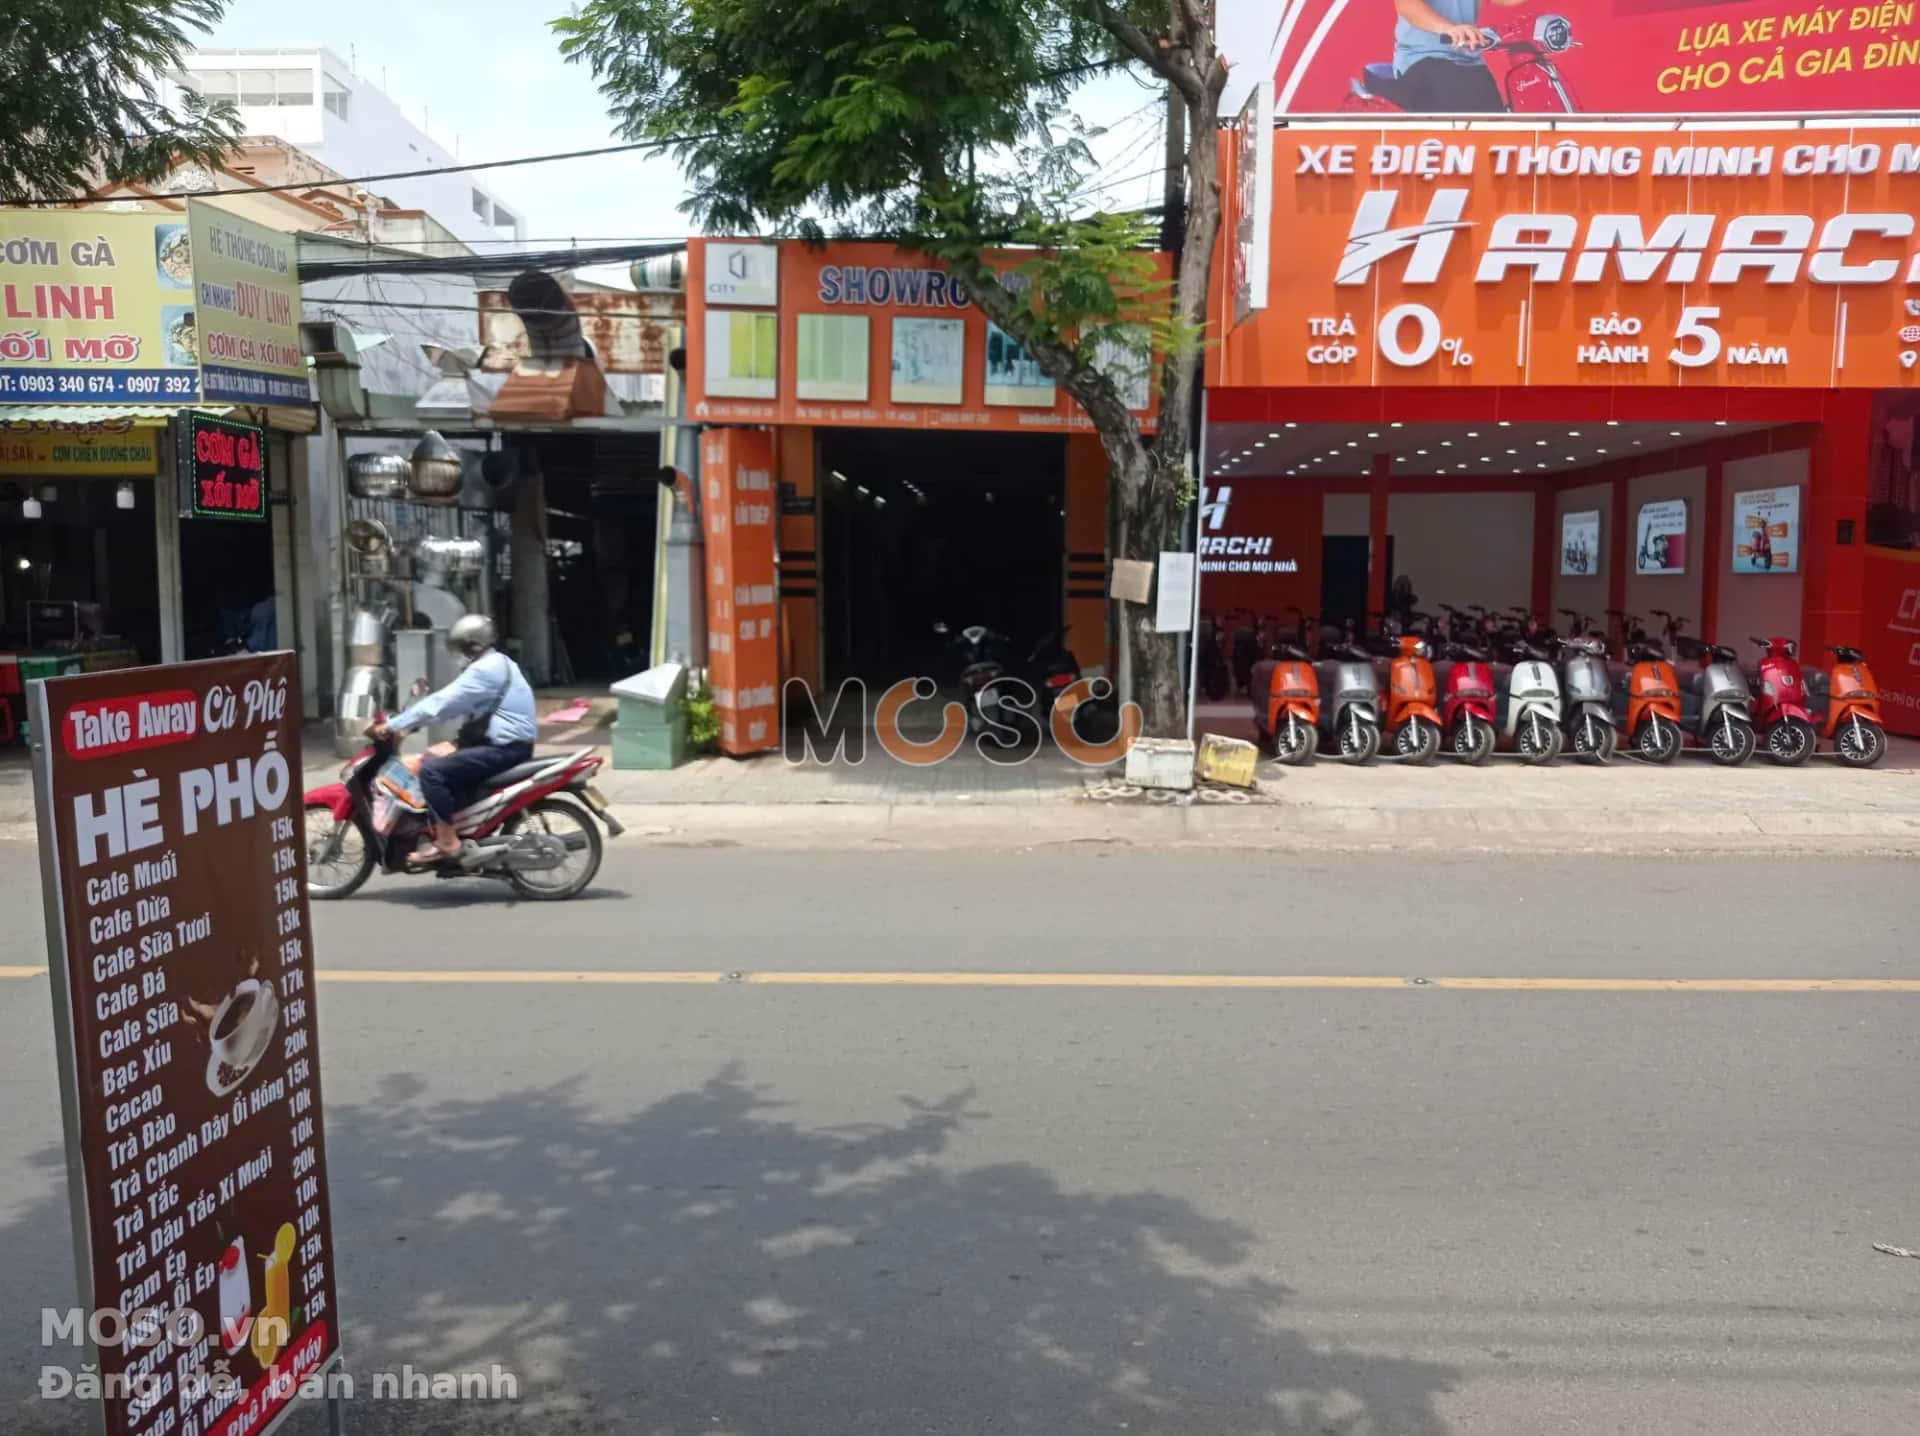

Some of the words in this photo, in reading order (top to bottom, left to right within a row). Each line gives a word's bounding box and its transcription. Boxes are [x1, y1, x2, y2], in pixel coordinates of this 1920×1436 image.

[1677, 23, 1731, 56] LỰA
[1738, 17, 1776, 44] XE
[1781, 5, 1844, 39] MÁY
[1849, 0, 1914, 34] ĐIỆN
[1656, 61, 1731, 94] CHO
[1738, 46, 1785, 85] CẢ
[1795, 46, 1853, 77] GIA
[1863, 34, 1920, 69] ĐÌN
[1295, 145, 1357, 175] XE
[1370, 139, 1476, 181] ĐIỆN
[1489, 140, 1641, 176] THÔNG
[1651, 145, 1774, 176] MINH
[1782, 143, 1881, 176] CHO
[70, 236, 115, 266] GÀ
[1333, 189, 1920, 285] HAMAC
[4, 284, 115, 319] LINH
[264, 289, 292, 326] LINH
[1308, 313, 1356, 336] TRẢ
[1589, 312, 1642, 336] BẢO
[0, 330, 48, 359] ỐI
[65, 334, 138, 360] MỠ
[1306, 340, 1358, 364] GÓP
[1577, 341, 1649, 364] HÀNH
[1668, 306, 1722, 367] 5
[0, 376, 16, 391] T:
[19, 375, 55, 392] 0903
[59, 376, 85, 392] 340
[88, 376, 114, 392] 674
[127, 377, 160, 393] 0907
[165, 377, 191, 393] 392
[196, 428, 235, 467] CƠM
[238, 431, 261, 471] GÀ
[1228, 561, 1250, 572] CHO
[1252, 561, 1272, 574] MỌI
[1274, 558, 1298, 572] NHÀ
[70, 707, 131, 750] Take
[138, 700, 197, 739] Away
[203, 685, 239, 733] Cà
[243, 677, 288, 730] Phê
[73, 768, 164, 867] HÈ
[179, 730, 290, 836] PHỐ
[86, 871, 129, 906] Cafe
[133, 849, 178, 890] Muối
[270, 816, 294, 842] 15k
[90, 909, 132, 944] Cafe
[136, 895, 171, 927] Dừa
[272, 847, 296, 874] 15k
[93, 945, 136, 982] Cafe
[140, 930, 173, 962] Sữa
[176, 911, 211, 947] Tươi
[274, 877, 299, 905] 15k
[96, 983, 139, 1020] Cafe
[142, 966, 166, 1000] Đá
[277, 907, 301, 936] 13k
[99, 1019, 141, 1058] Cafe
[146, 1002, 179, 1035] Sữa
[279, 938, 303, 966] 15k
[102, 1060, 139, 1097] Bạc
[280, 968, 305, 997] 17k
[106, 1084, 162, 1134] Cacao
[283, 998, 306, 1028] 15k
[107, 1132, 139, 1171] Trà
[142, 1112, 176, 1150] Đào
[284, 1027, 308, 1060] 20k
[110, 1168, 141, 1208] Trà
[145, 1132, 198, 1184] Chanh
[201, 1113, 229, 1148] Dây
[250, 1077, 284, 1115] Hồng
[286, 1057, 310, 1089] 15k
[113, 1204, 144, 1245] Trà
[147, 1180, 179, 1220] Tắc
[288, 1087, 312, 1118] 10k
[116, 1241, 147, 1281] Trà
[151, 1216, 184, 1257] Dâu
[186, 1189, 216, 1228] Tắc
[219, 1172, 235, 1205] Xí
[238, 1145, 272, 1191] Muội
[290, 1117, 314, 1148] 10k
[297, 1204, 320, 1237] 10k
[120, 1270, 161, 1317] Cam
[165, 1249, 186, 1281] Ép
[292, 1146, 316, 1179] 20k
[195, 1262, 215, 1295] Ép
[295, 1175, 318, 1208] 10k
[299, 1233, 322, 1266] 15k
[302, 1262, 324, 1295] 15k
[304, 1290, 326, 1324] 15k
